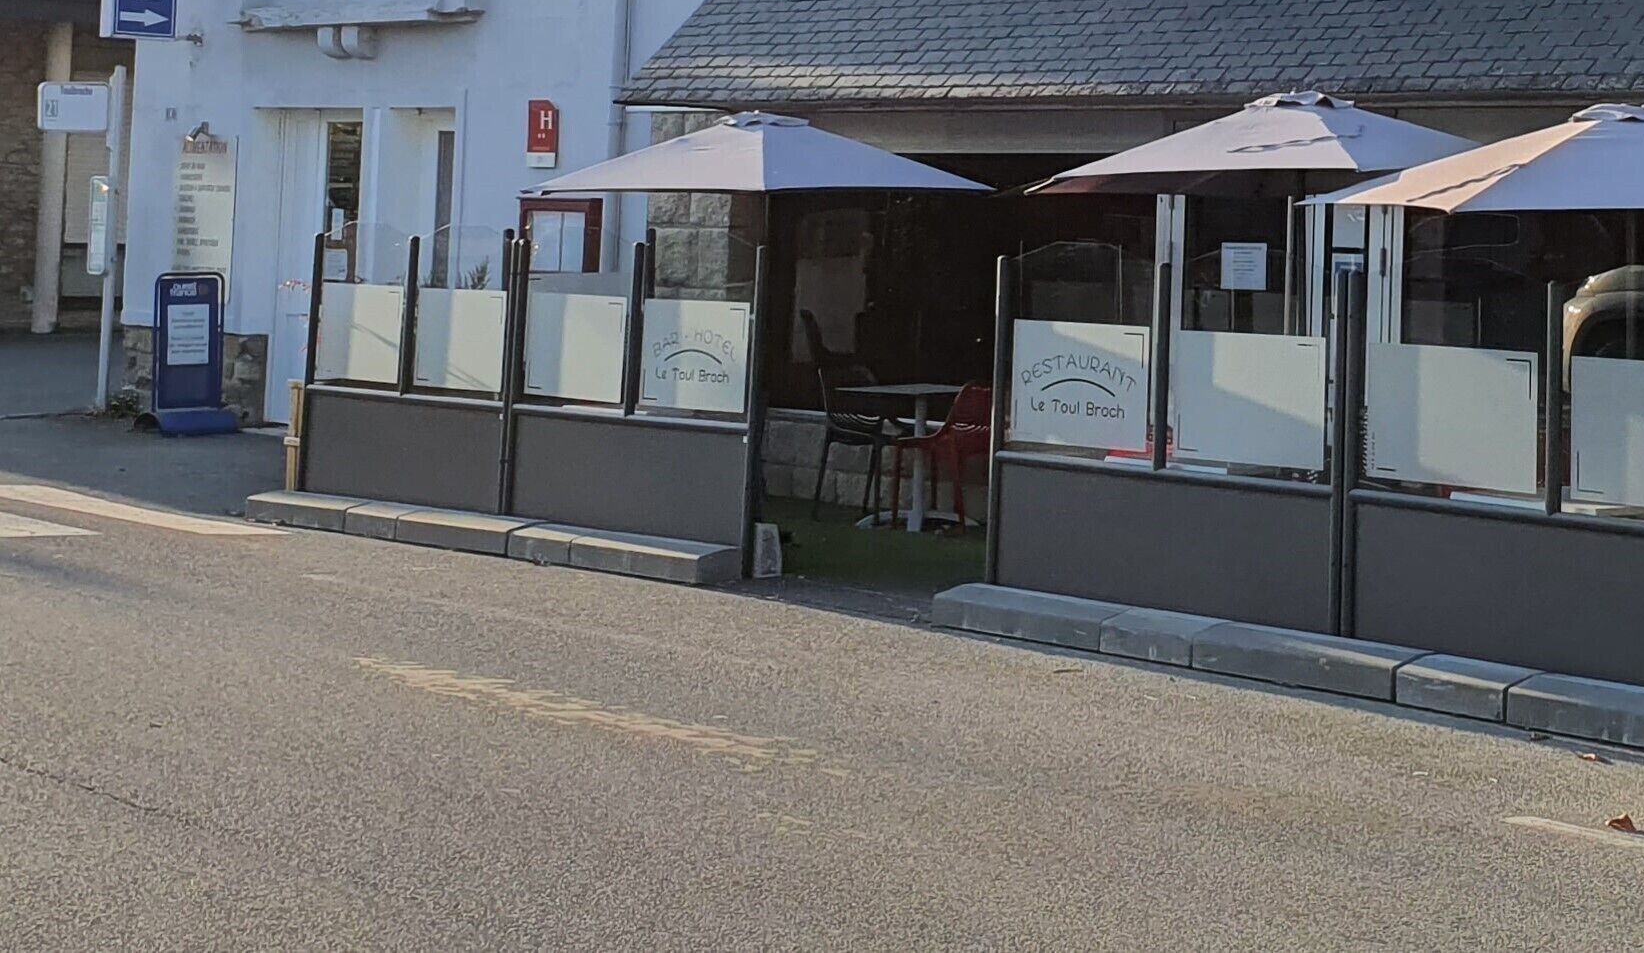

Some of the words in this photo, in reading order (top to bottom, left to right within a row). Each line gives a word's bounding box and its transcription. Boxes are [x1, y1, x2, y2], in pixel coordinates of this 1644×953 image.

[539, 110, 553, 130] H
[652, 331, 680, 359] BAR
[694, 329, 738, 363] HOTEL
[655, 366, 667, 380] Le
[672, 367, 695, 382] Toul
[698, 369, 730, 384] Broch
[1020, 353, 1137, 393] RESTAURANT
[1030, 397, 1045, 413] Le
[1052, 398, 1080, 415] Toul
[1086, 401, 1125, 419] Broch
